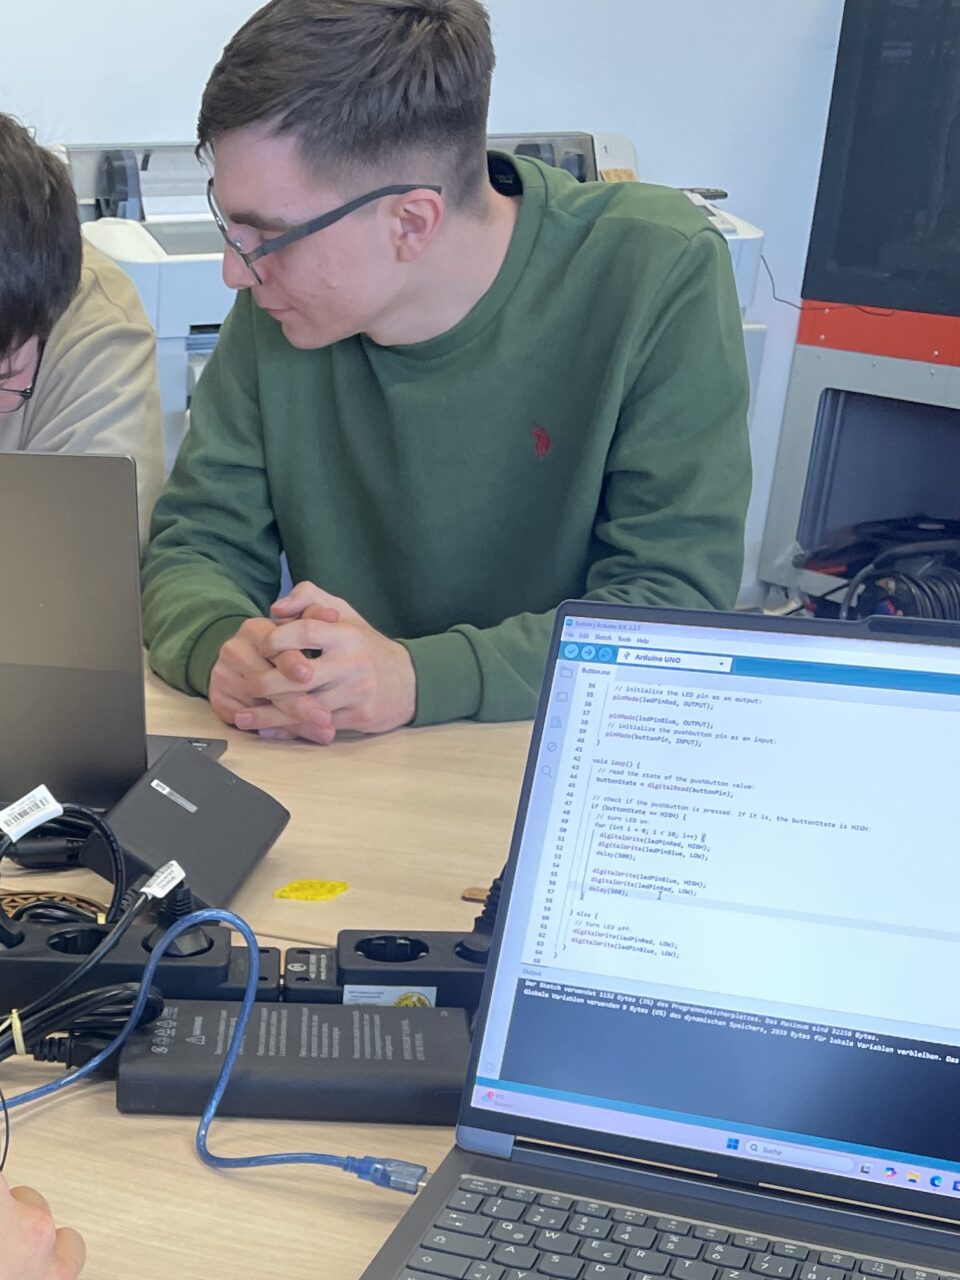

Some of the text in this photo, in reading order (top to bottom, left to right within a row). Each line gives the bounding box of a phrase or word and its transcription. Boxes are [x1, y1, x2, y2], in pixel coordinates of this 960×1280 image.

[634, 653, 681, 664] Arduino UNO
[502, 1222, 513, 1230] Q
[545, 1230, 560, 1239] W
[504, 1245, 515, 1254] A
[636, 1250, 646, 1258] R
[595, 1264, 605, 1272] D
[684, 1260, 692, 1268] T
[517, 1271, 527, 1279] Y
[729, 1270, 740, 1278] Z
